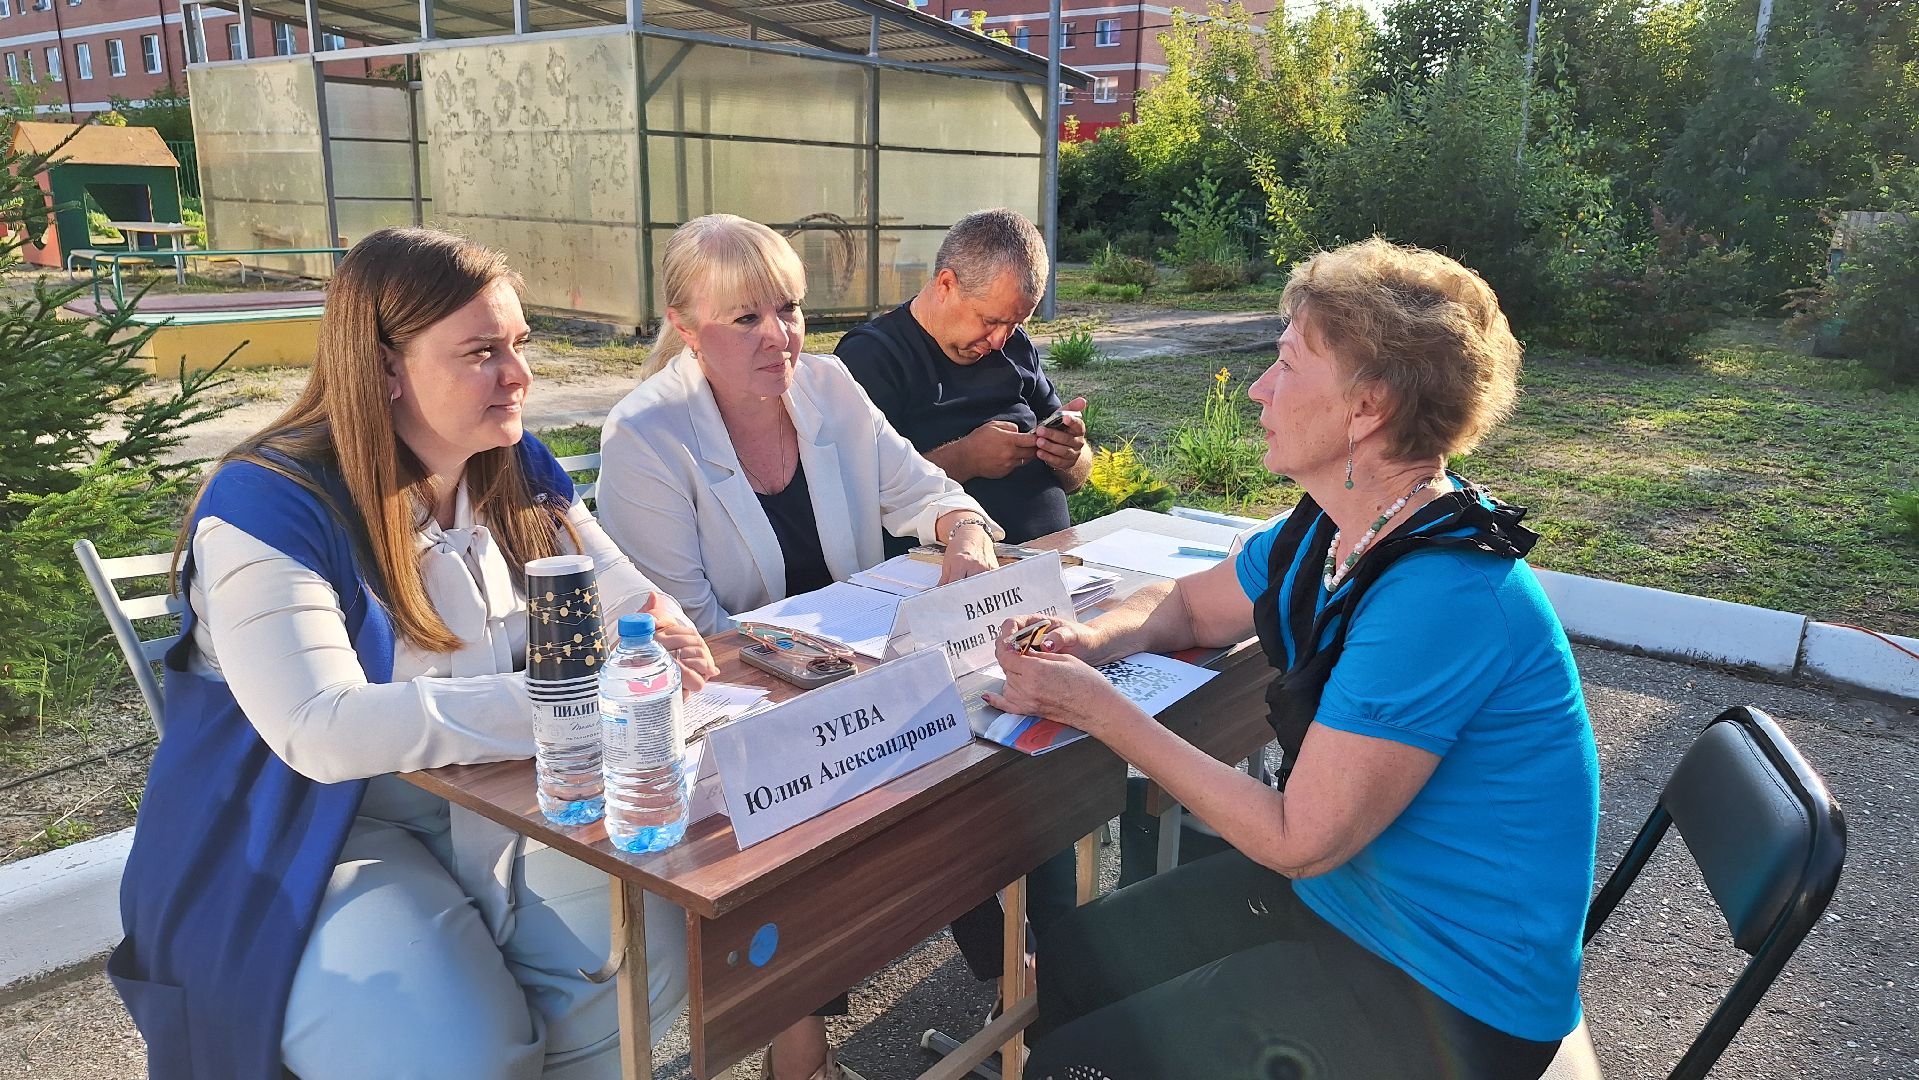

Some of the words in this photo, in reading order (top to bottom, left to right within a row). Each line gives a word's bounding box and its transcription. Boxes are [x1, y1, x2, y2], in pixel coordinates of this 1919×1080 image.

[964, 586, 1024, 621] ВАВРИК
[553, 700, 600, 718] ПИЛИГ
[812, 703, 885, 747] ЗУЕВА
[744, 773, 813, 816] Юлия
[819, 712, 957, 785] Александровна
